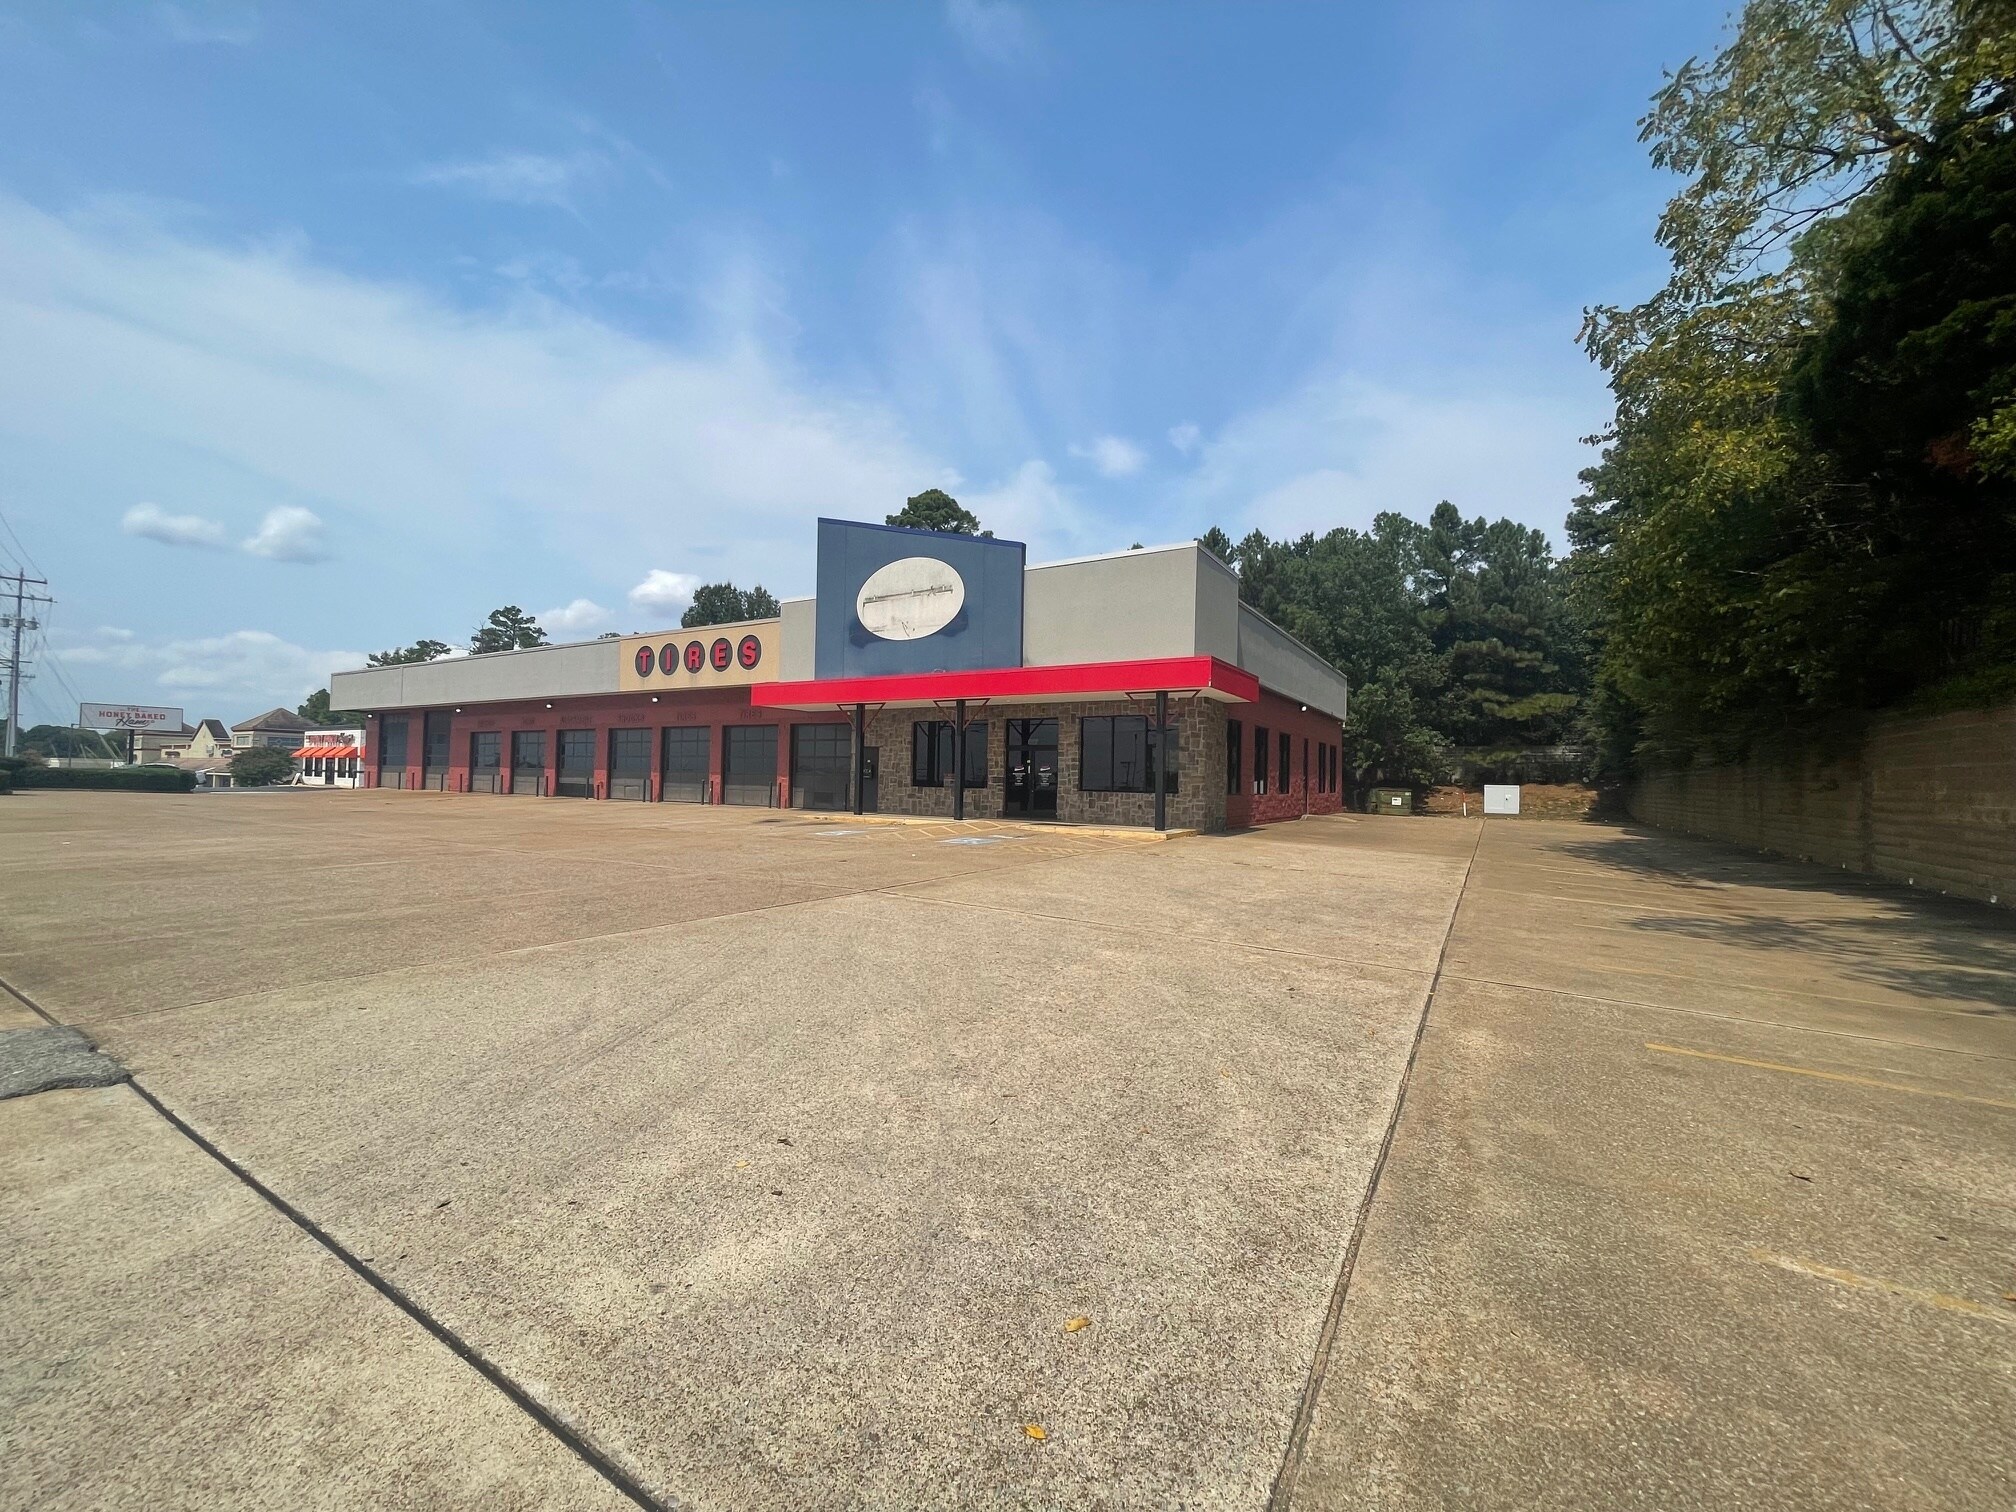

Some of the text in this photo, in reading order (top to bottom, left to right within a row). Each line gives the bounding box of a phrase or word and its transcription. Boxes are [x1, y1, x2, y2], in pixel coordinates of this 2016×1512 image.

[639, 641, 757, 673] TIRES
[99, 711, 166, 720] HONEY BAKED
